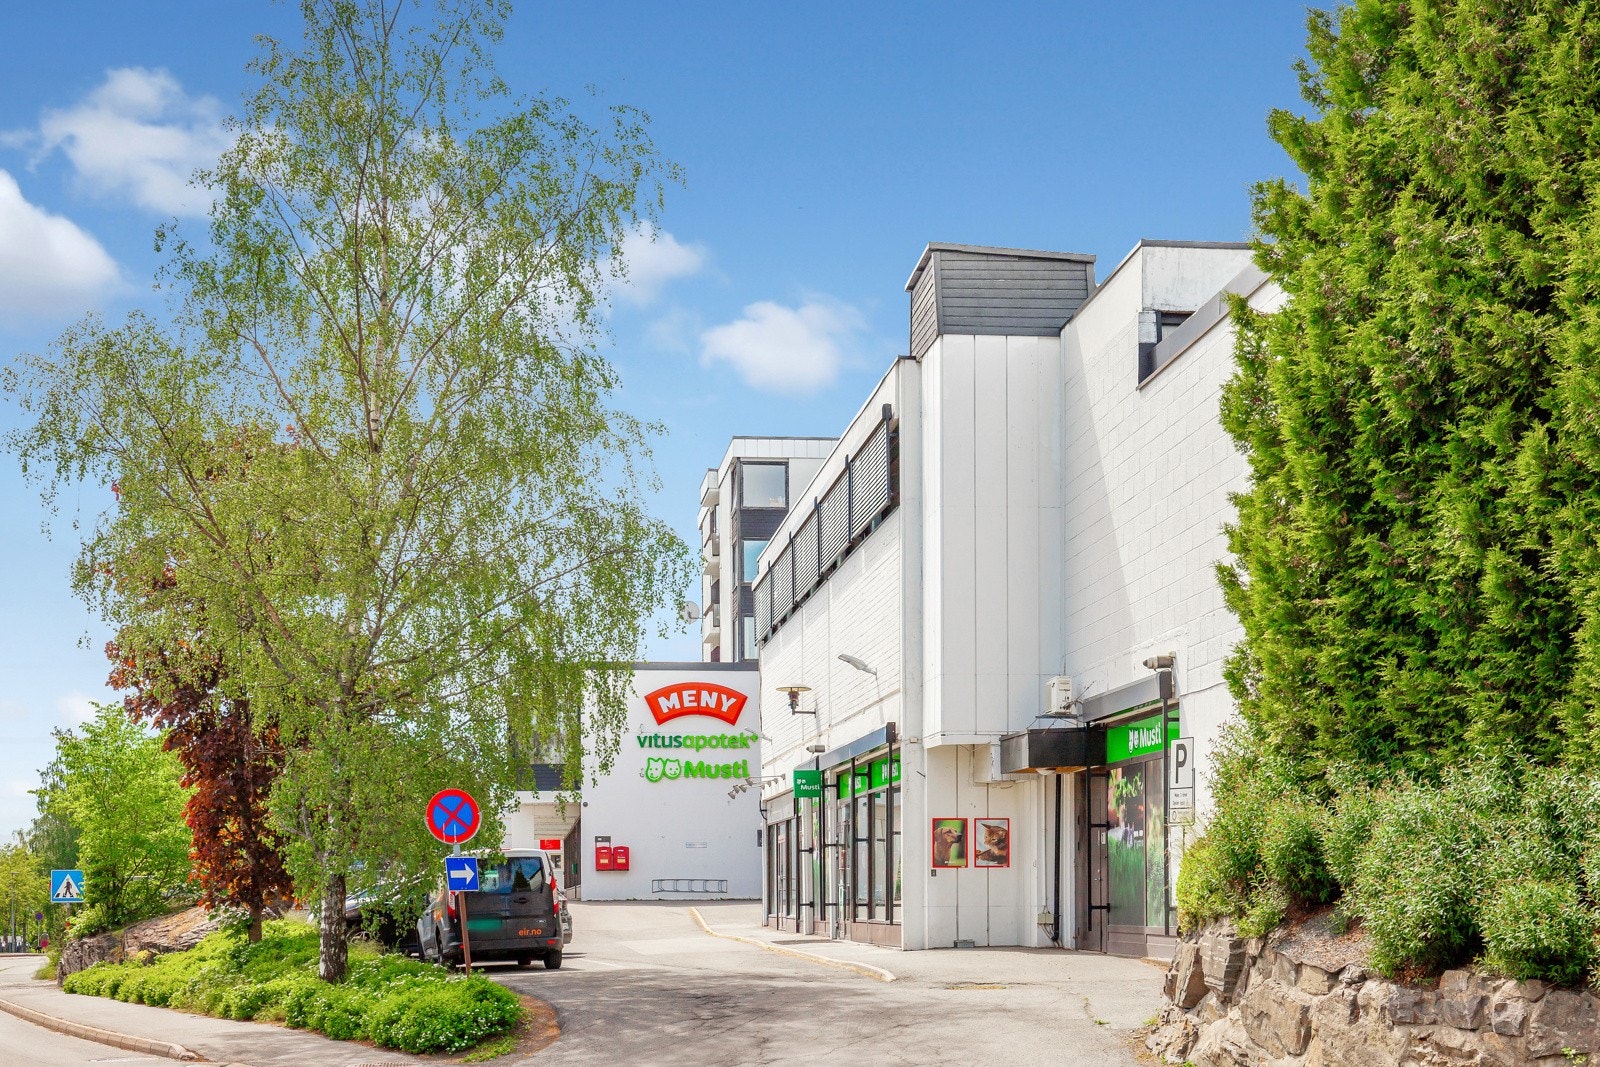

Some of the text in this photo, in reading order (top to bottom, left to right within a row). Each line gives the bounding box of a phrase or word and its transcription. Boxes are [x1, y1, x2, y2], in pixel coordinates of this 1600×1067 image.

[657, 690, 737, 714] MENY
[637, 732, 751, 753] vitusapotek
[1139, 722, 1162, 748] Musti
[684, 759, 750, 779] Musti
[1175, 743, 1188, 784] P
[800, 783, 820, 791] Musti
[518, 928, 542, 936] eir.no
